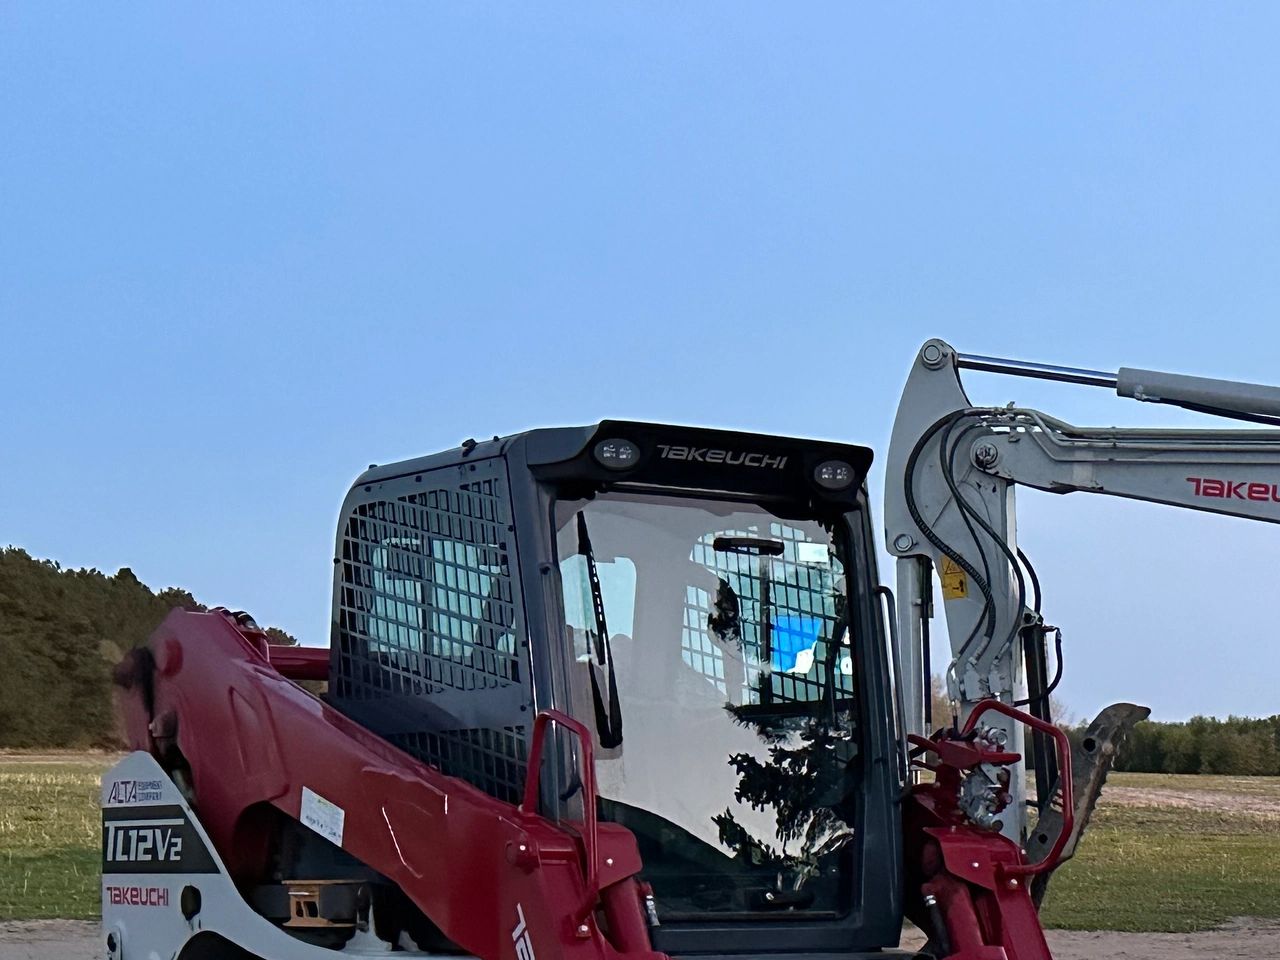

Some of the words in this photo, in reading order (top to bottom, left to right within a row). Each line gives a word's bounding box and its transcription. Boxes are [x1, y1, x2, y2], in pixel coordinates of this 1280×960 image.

[656, 444, 788, 469] TAKEUCHI
[108, 780, 137, 804] ALTA
[107, 886, 169, 907] TAKEUCHI
